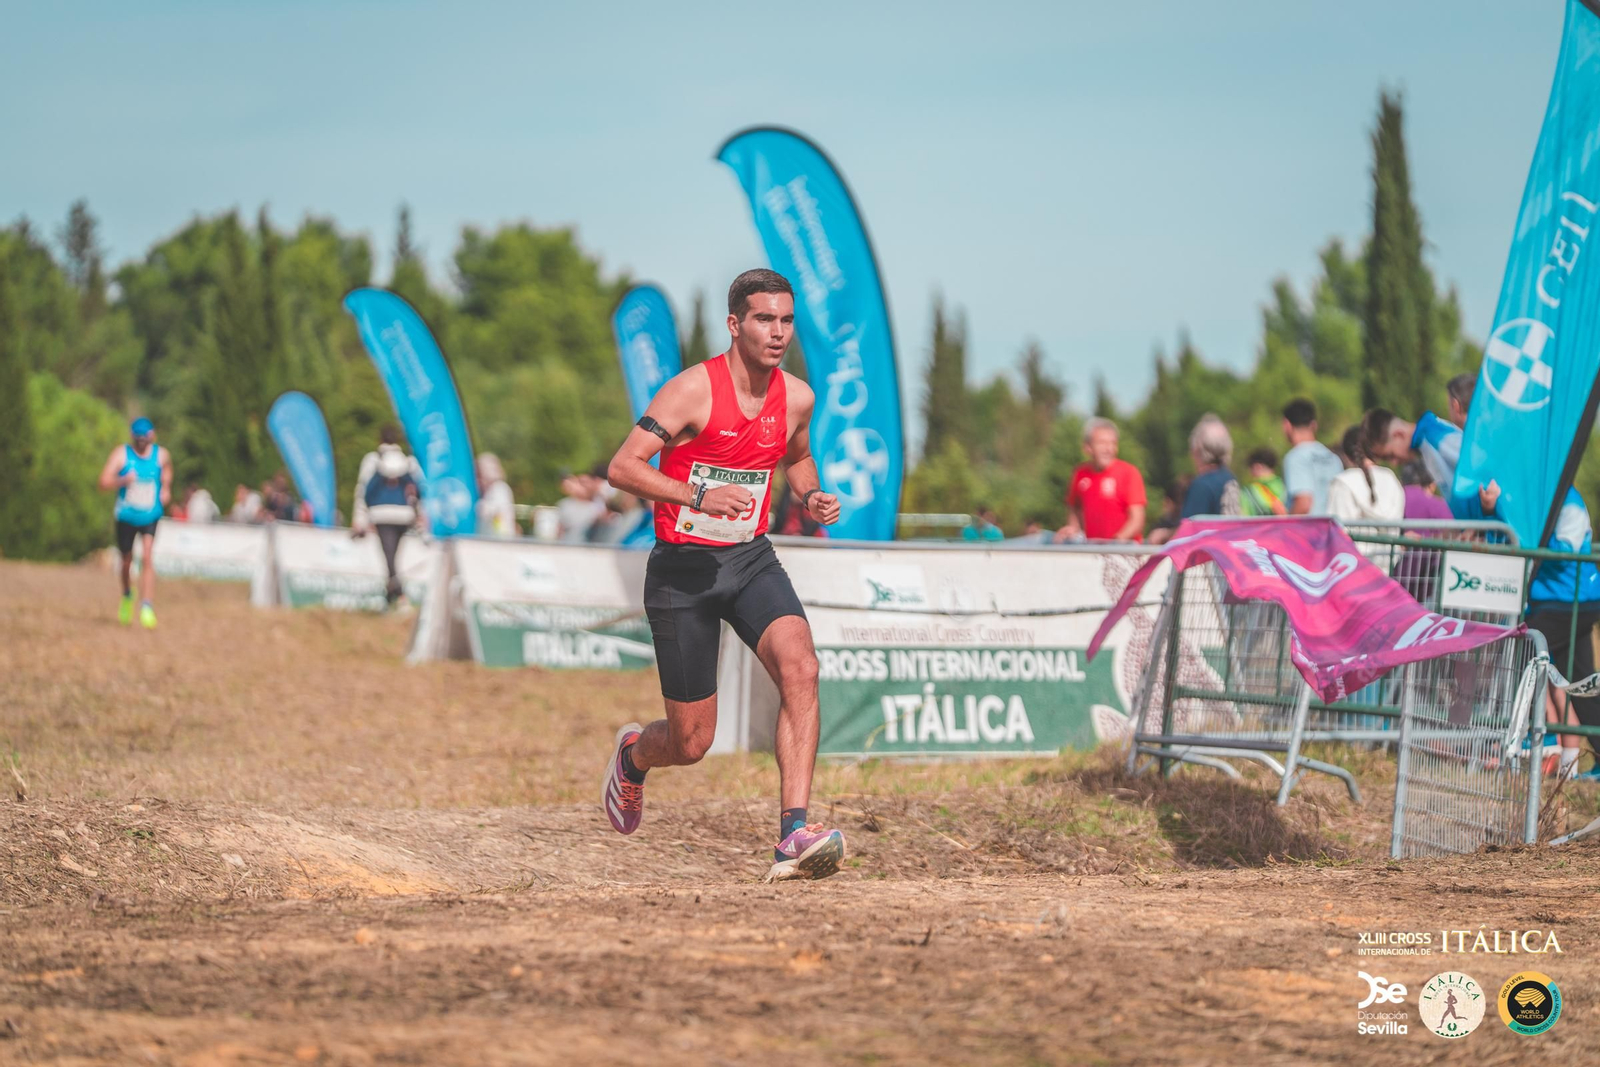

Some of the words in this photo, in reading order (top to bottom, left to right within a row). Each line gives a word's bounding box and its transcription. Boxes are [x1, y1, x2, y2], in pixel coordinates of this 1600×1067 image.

[715, 470, 751, 483] ITÁLICA
[1484, 581, 1518, 595] Sevilla
[840, 623, 933, 644] International
[935, 623, 974, 644] Cross
[978, 623, 1036, 648] Country
[890, 650, 1087, 682] INTERNACIONAL
[880, 681, 1035, 743] ITÁLICA
